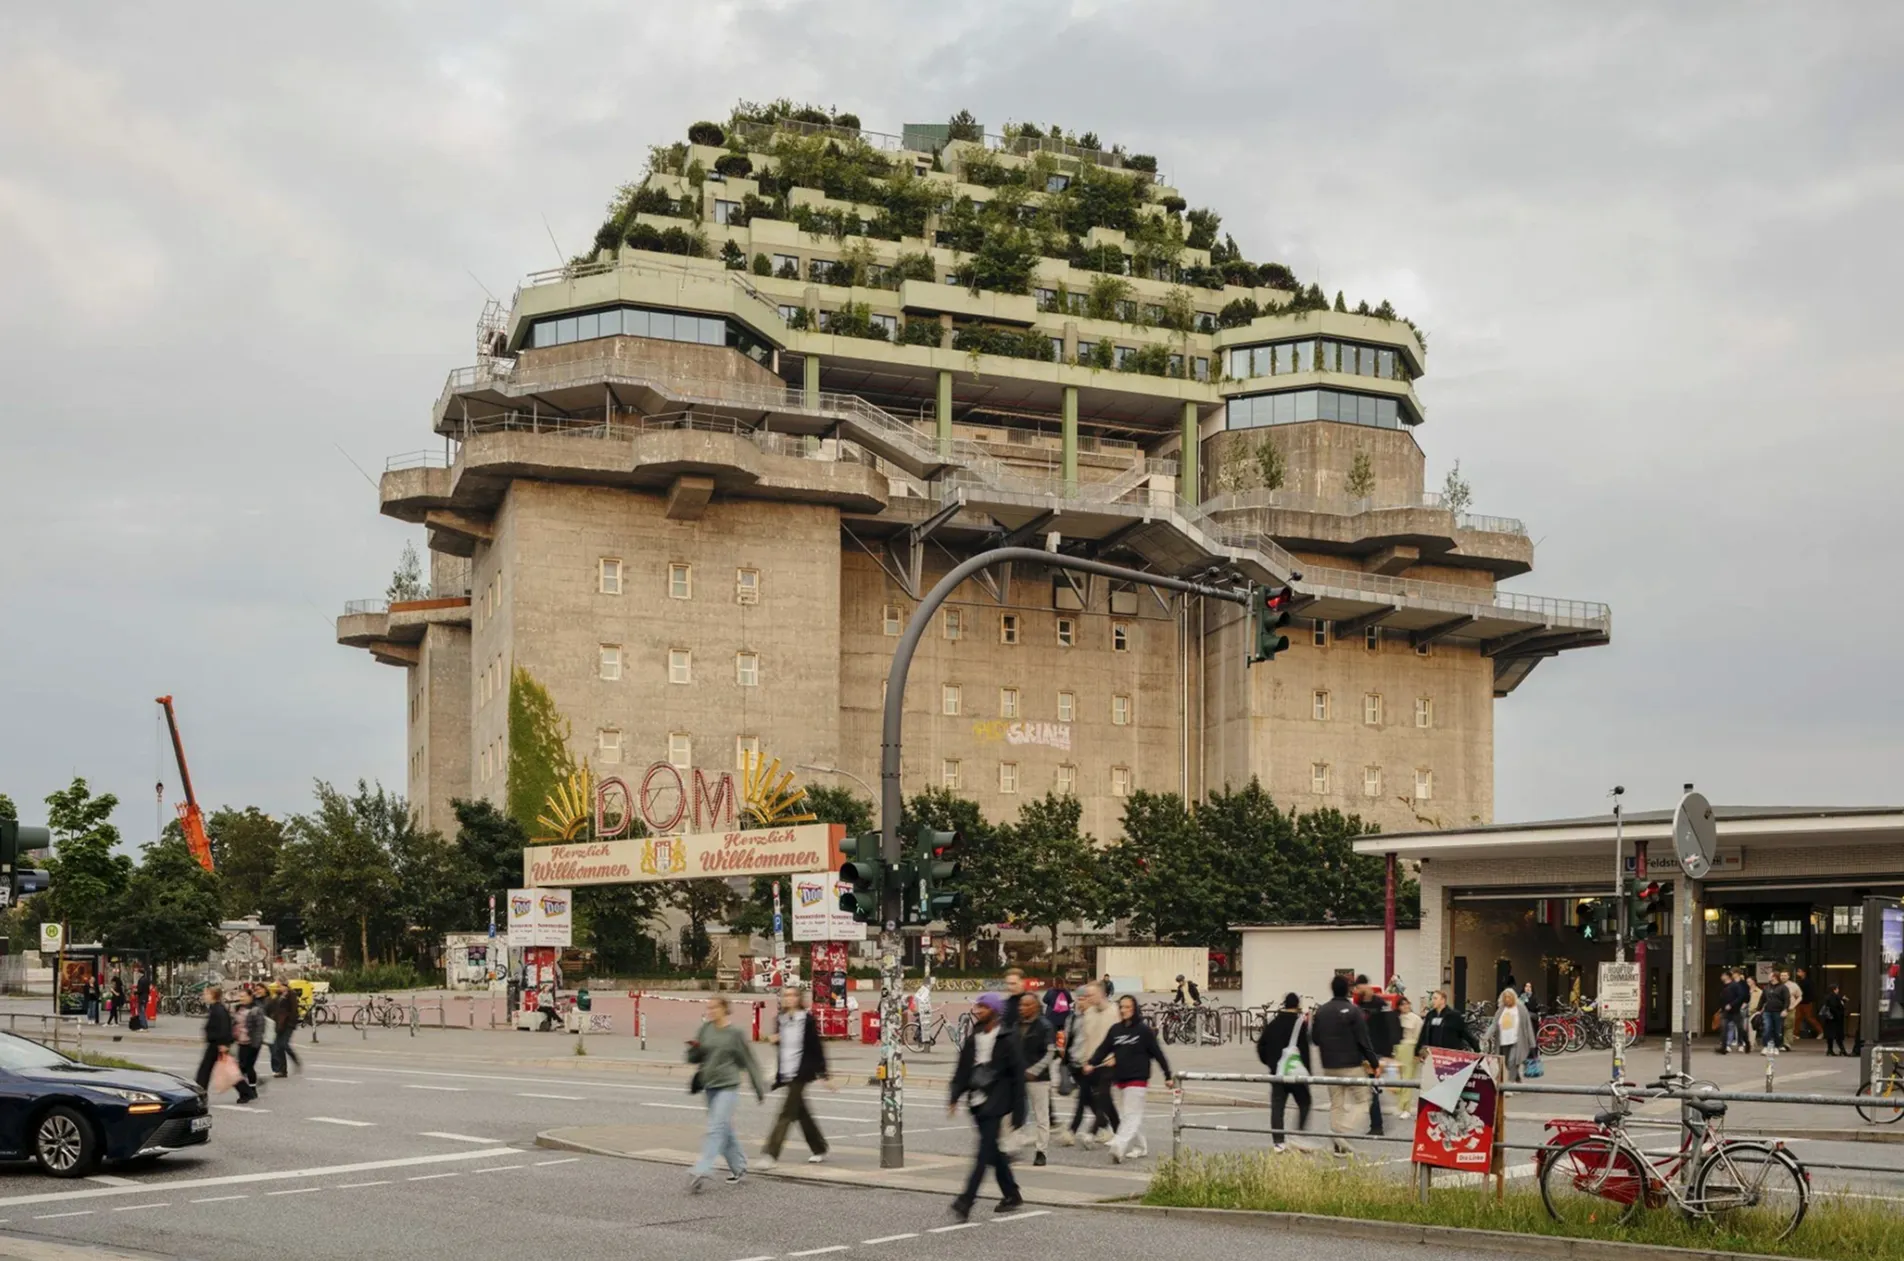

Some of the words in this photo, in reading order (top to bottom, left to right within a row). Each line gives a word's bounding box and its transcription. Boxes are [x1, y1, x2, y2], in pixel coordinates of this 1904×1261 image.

[595, 760, 734, 838] DOM
[724, 828, 797, 848] Herzlich
[551, 845, 611, 861] Herzlich
[700, 849, 820, 872] Willkommen
[531, 860, 630, 882] Willkommen
[1603, 973, 1639, 982] FLOHMARKT
